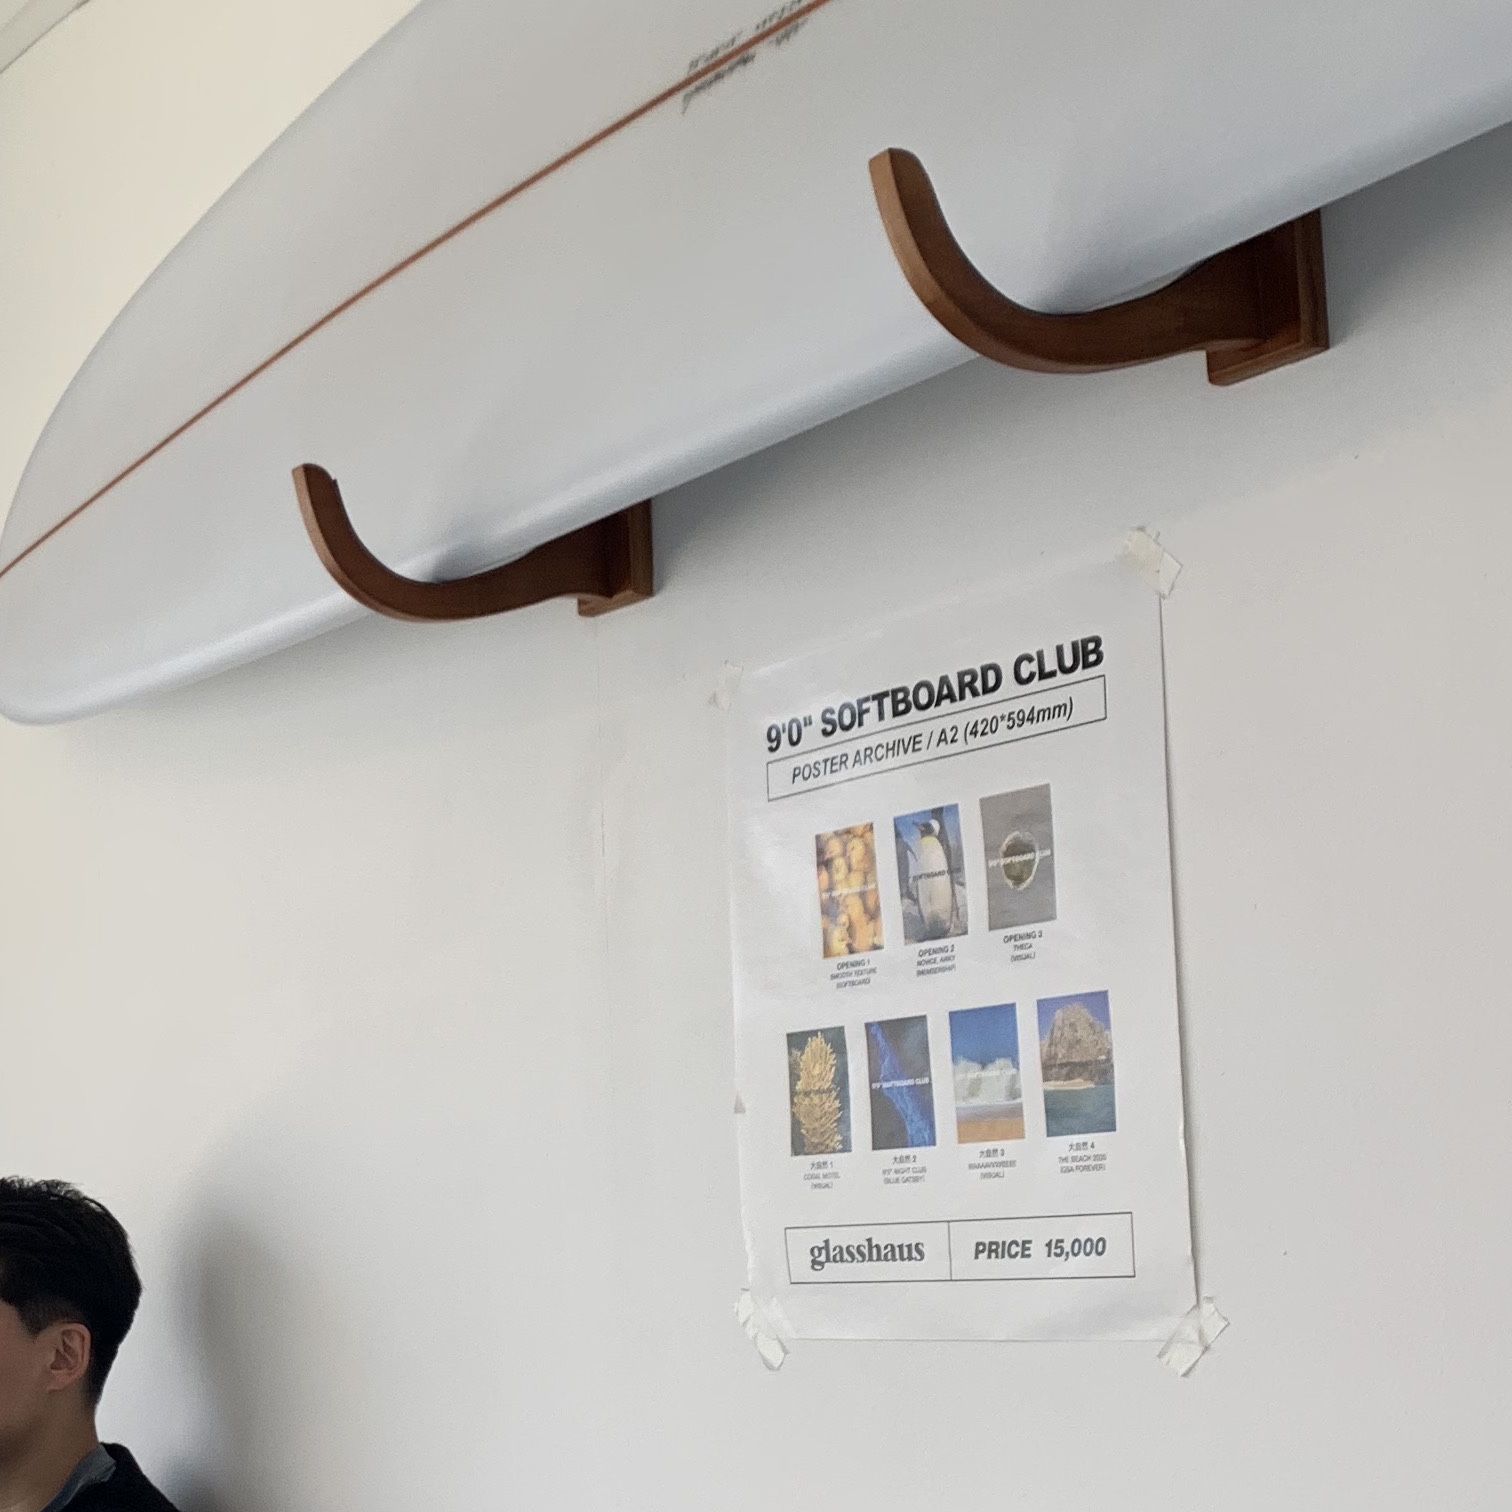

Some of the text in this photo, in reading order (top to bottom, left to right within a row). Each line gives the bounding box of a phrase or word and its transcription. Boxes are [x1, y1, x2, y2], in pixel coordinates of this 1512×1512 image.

[766, 635, 1104, 752] 9'0" SOFTBOARD CLUB
[792, 752, 849, 784] POSTER
[852, 732, 923, 768] ARCHIVE
[937, 725, 959, 747] A2
[1003, 930, 1043, 943] OPENING 3
[918, 944, 955, 957] OPENING 2
[837, 959, 866, 970] OPENING
[809, 1237, 925, 1271] glasshaus
[974, 1236, 1107, 1261] PRICE 15,000
